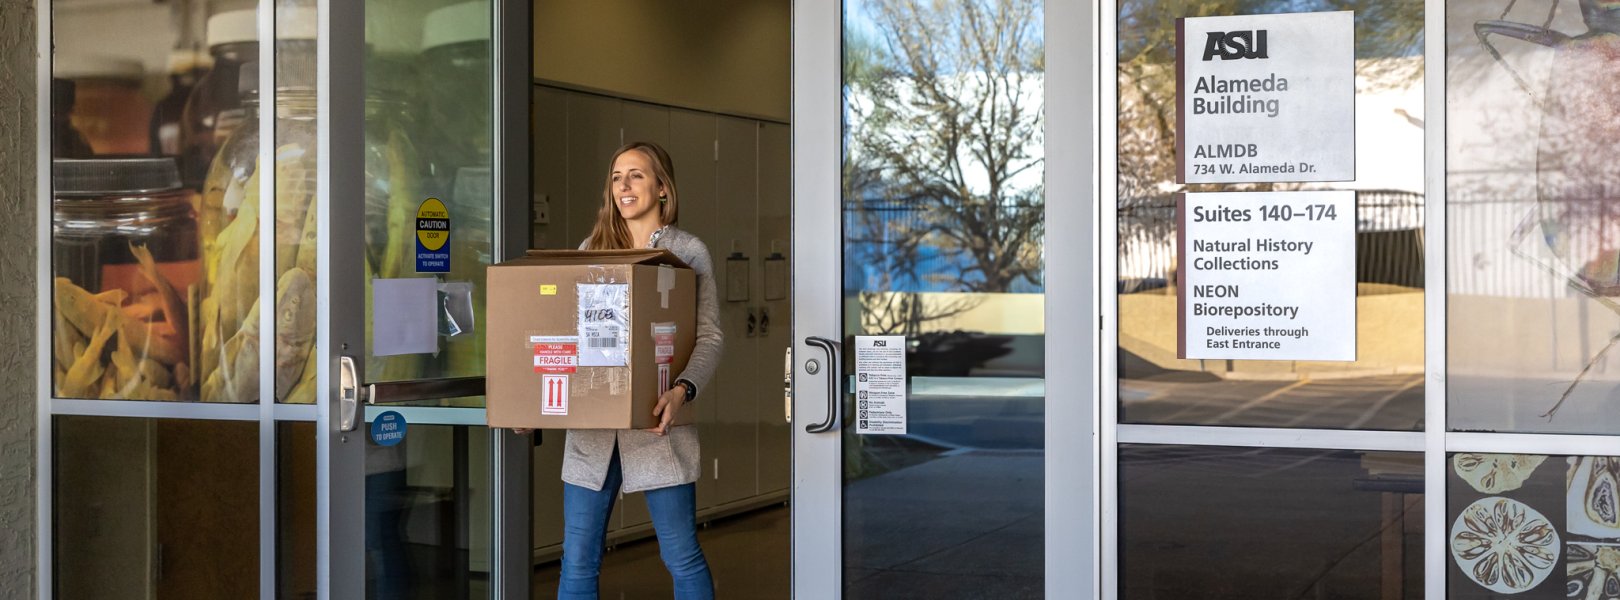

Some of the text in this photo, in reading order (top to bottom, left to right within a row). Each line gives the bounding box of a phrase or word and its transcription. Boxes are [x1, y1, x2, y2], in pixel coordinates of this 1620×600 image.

[1202, 30, 1269, 61] ASU
[1194, 73, 1288, 94] Alameda
[1193, 95, 1279, 118] Building
[1194, 144, 1258, 158] ALMDB
[1194, 162, 1316, 175] 734 W. Alameda Dr.
[1193, 205, 1252, 222] Suites
[420, 221, 446, 229] CAUTION
[1193, 238, 1313, 255] Natural History
[1193, 257, 1279, 270] Collections
[1193, 285, 1239, 298] NEON
[1193, 303, 1299, 319] Biorepository
[1206, 326, 1309, 339] Deliveries through
[1206, 339, 1281, 349] East Entrance
[381, 423, 397, 431] PUSH
[383, 432, 402, 440] OPERATE
